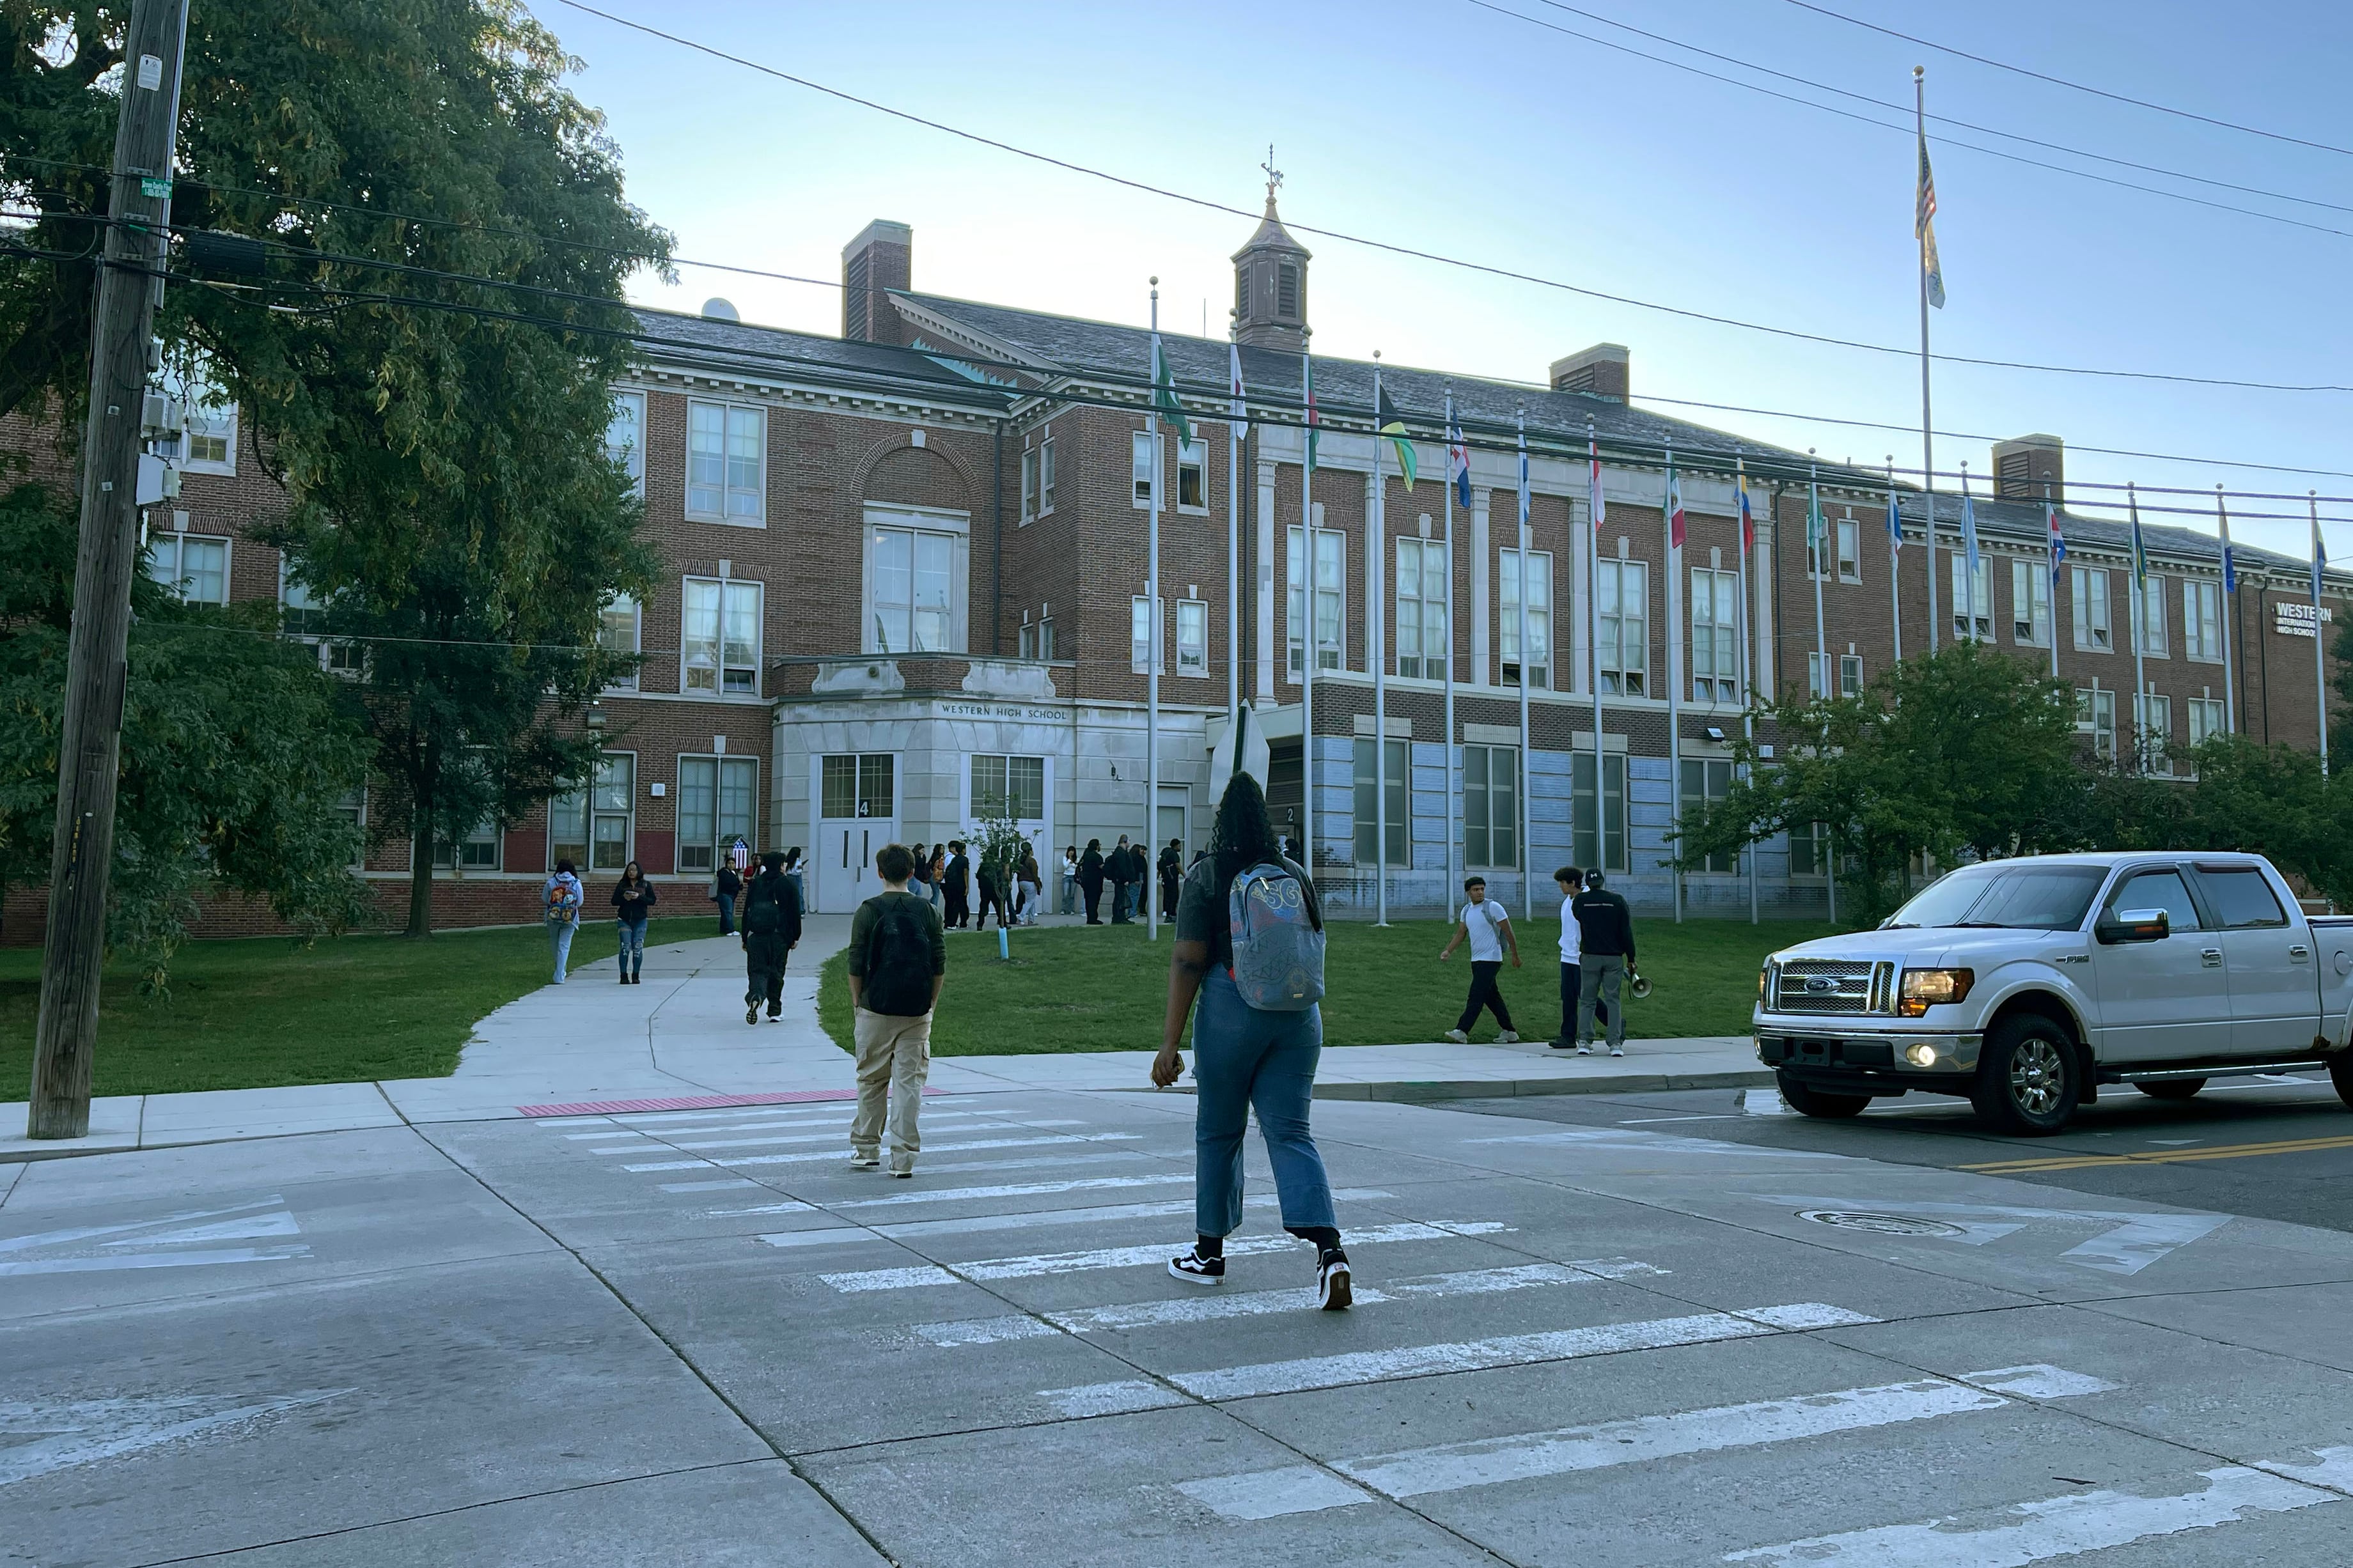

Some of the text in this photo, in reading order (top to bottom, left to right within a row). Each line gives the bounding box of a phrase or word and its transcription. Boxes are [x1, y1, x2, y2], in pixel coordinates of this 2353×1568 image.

[2276, 602, 2331, 621] WESTERN
[2276, 617, 2322, 630] INTERNATION
[2276, 626, 2293, 634] HIGH
[942, 704, 1067, 720] WESTERN HIGH SCHOOL
[859, 801, 869, 816] 4
[1288, 808, 1294, 821] 2
